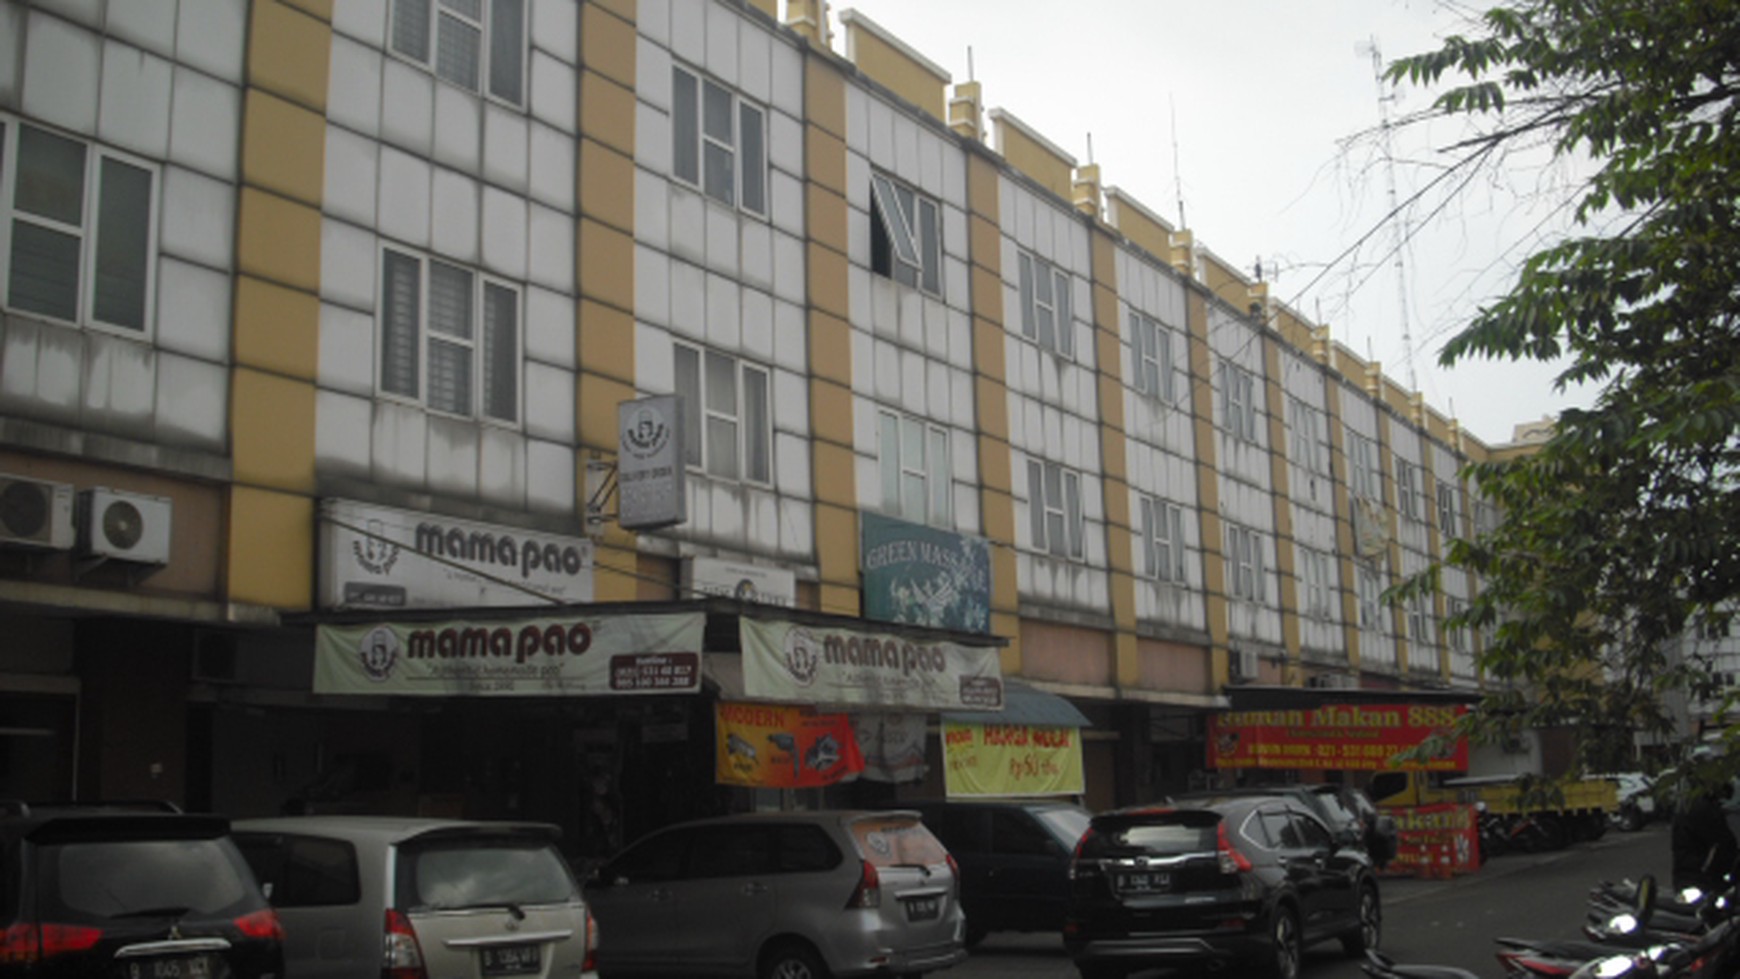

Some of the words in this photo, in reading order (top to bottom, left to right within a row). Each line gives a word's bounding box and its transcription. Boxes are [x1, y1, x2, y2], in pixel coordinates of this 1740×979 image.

[867, 540, 917, 570] GREEN
[720, 703, 786, 727] MODERN
[1310, 705, 1401, 728] Makan
[1408, 705, 1457, 728] 888
